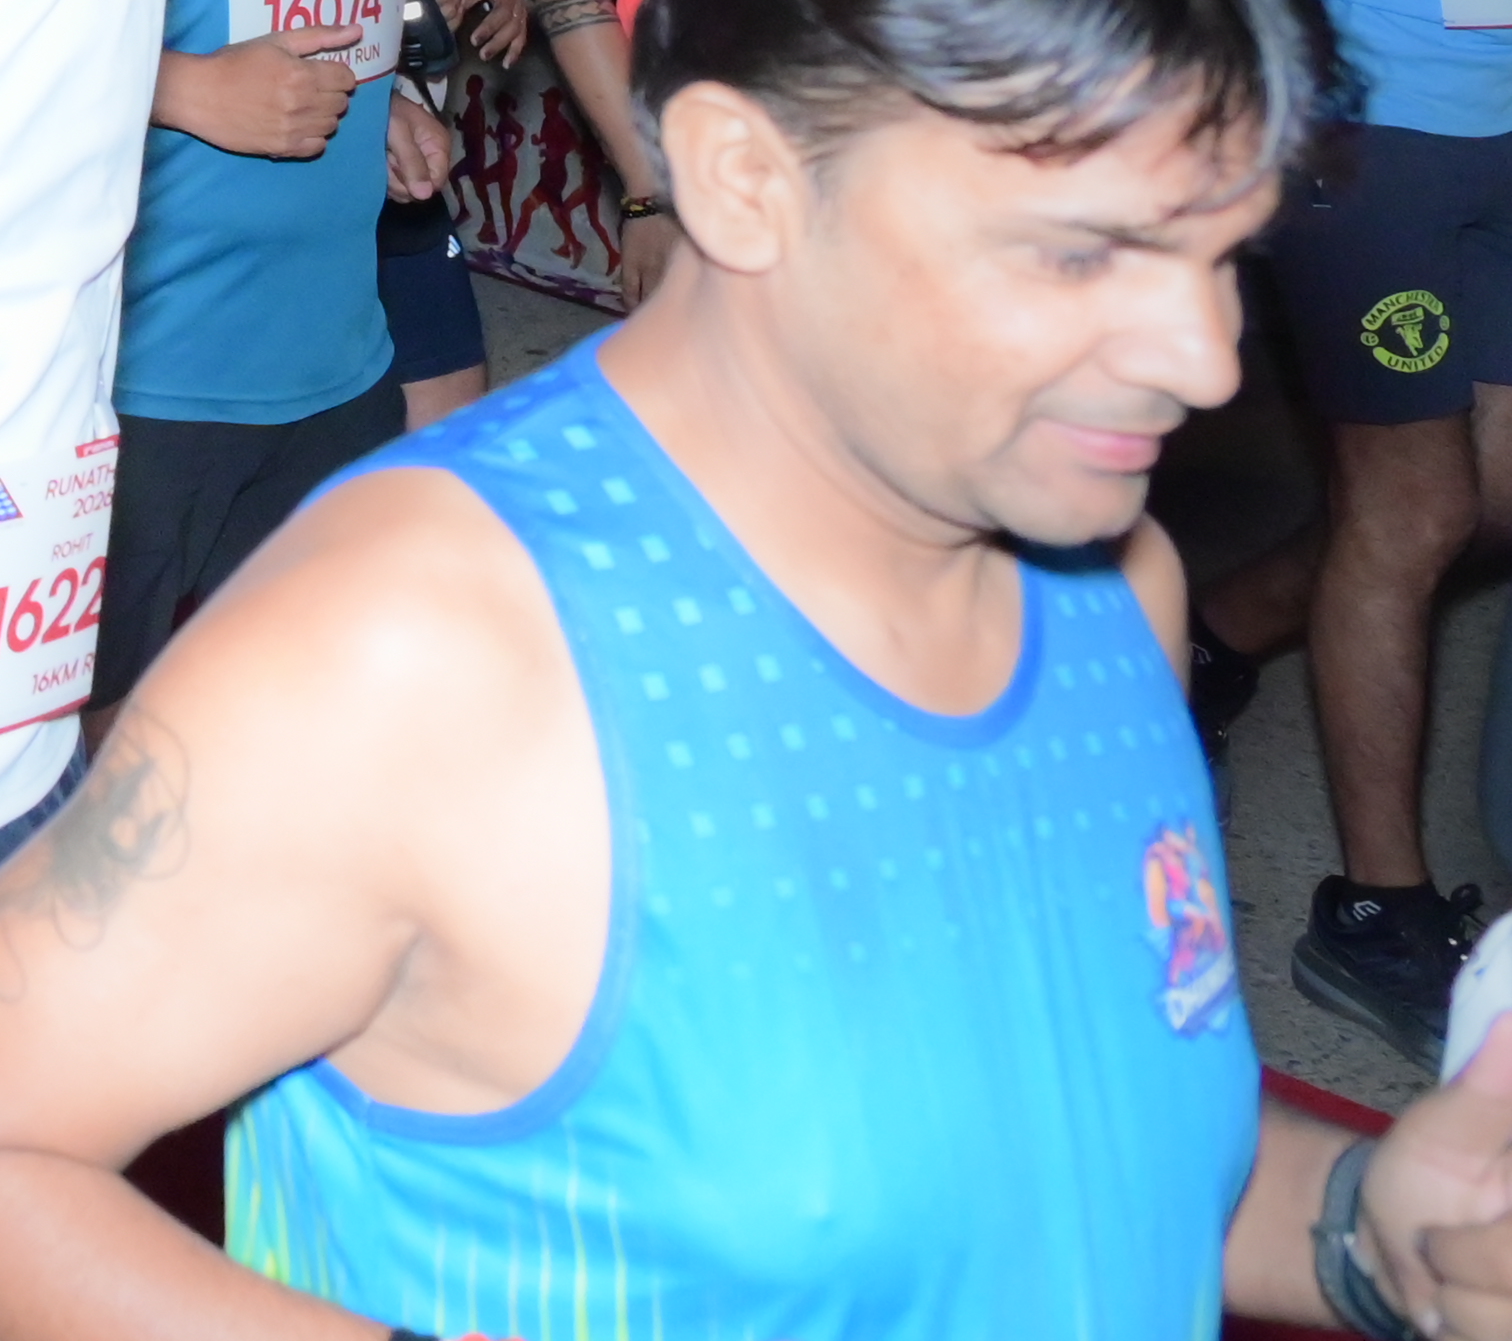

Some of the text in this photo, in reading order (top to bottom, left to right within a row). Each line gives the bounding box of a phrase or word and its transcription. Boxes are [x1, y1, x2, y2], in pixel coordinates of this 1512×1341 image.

[355, 42, 381, 65] RUN
[1387, 345, 1444, 371] UNITED
[72, 487, 114, 519] 2026
[50, 532, 94, 561] ROHIT
[32, 658, 80, 695] 16KM
